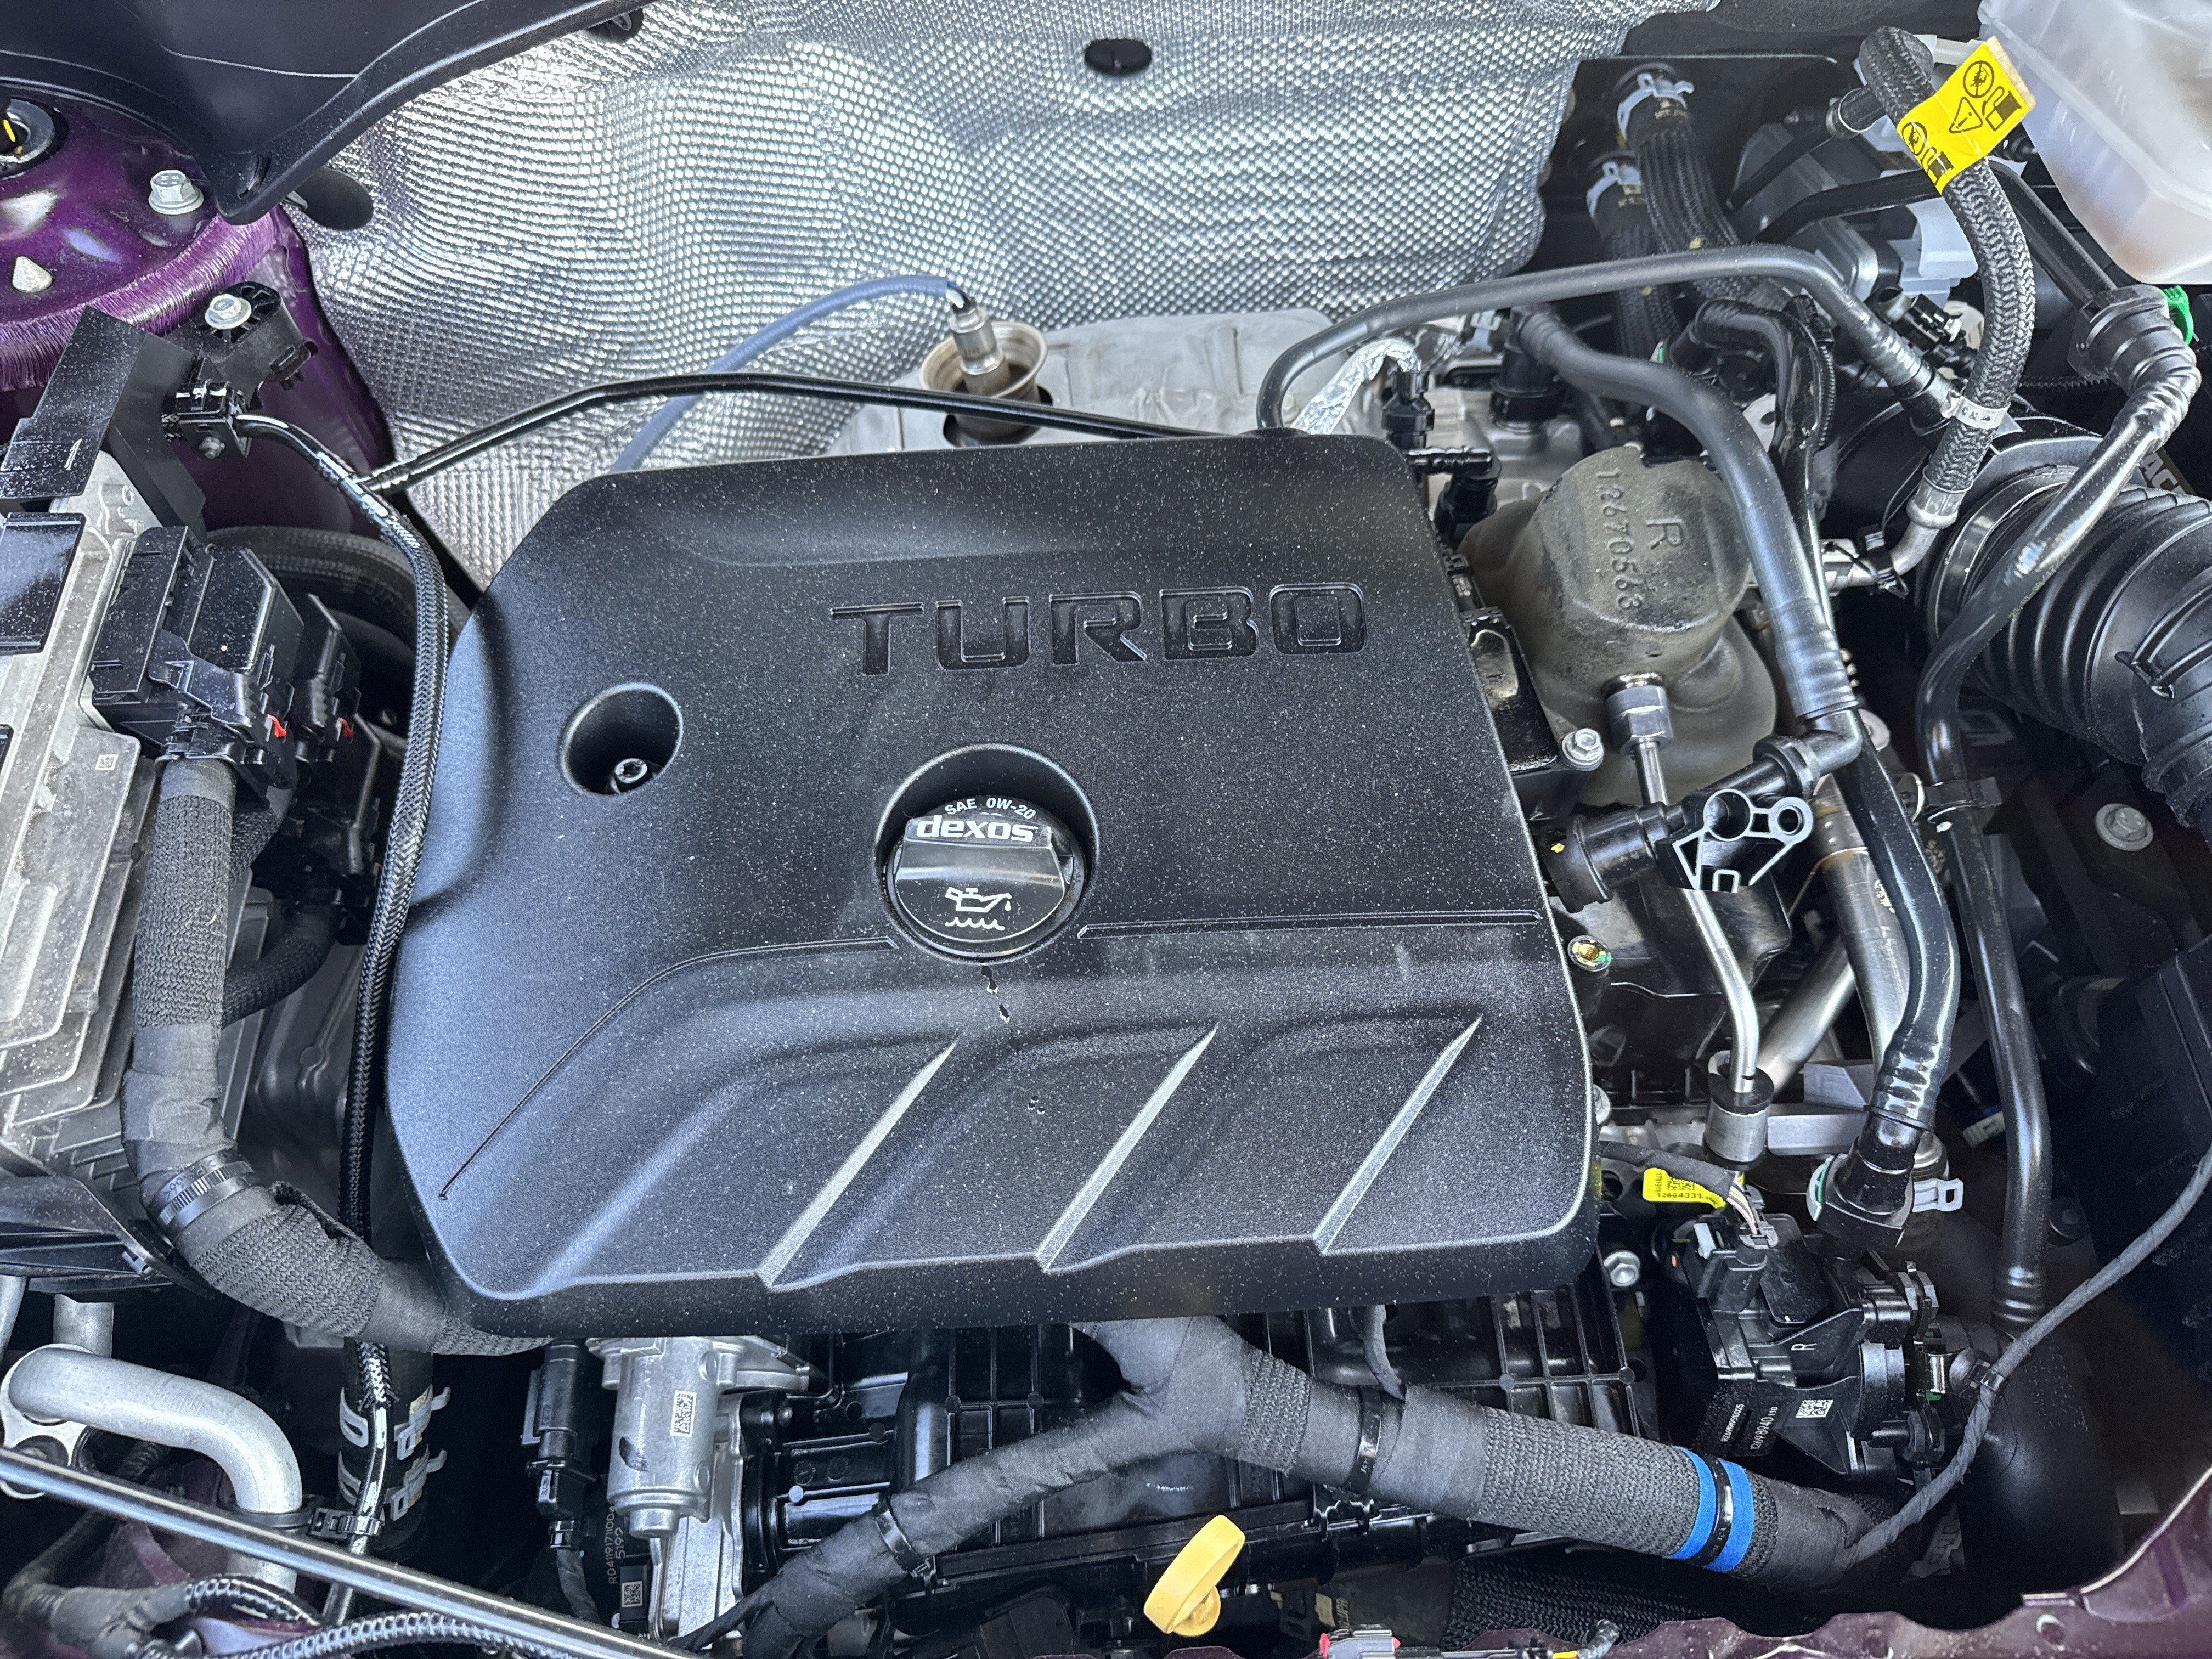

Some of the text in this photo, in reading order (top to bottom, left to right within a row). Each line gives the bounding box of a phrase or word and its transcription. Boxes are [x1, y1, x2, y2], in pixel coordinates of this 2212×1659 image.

[1596, 467, 1646, 610] 12670563
[1646, 515, 1683, 550] R
[830, 583, 1367, 676] TURBO
[945, 798, 1036, 819] SAE 0W-20
[916, 815, 1034, 842] dexos
[1791, 1342, 1817, 1351] R
